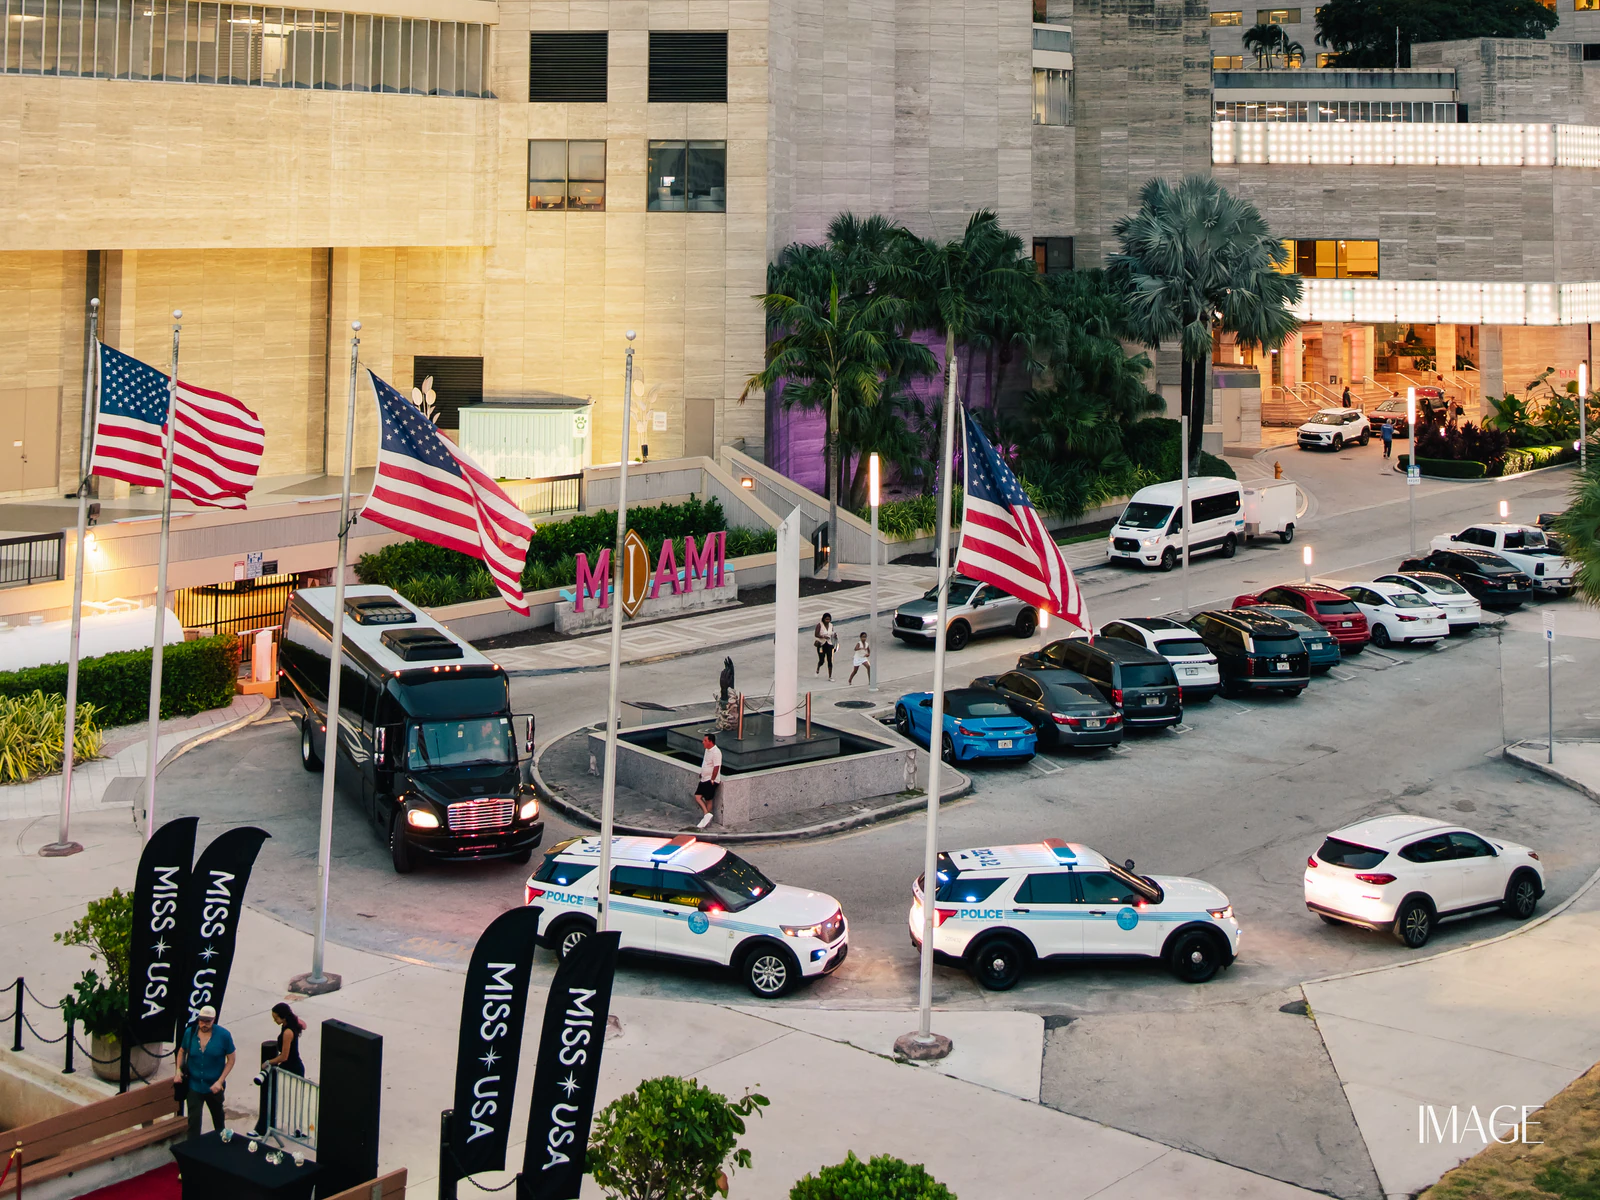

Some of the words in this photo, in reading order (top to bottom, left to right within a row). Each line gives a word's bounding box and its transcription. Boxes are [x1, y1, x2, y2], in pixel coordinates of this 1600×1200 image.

[572, 530, 727, 614] MIAMI
[150, 866, 180, 932] MISS
[200, 870, 235, 938] MISS
[546, 890, 585, 905] POLICE
[960, 908, 1004, 919] POLICE
[141, 962, 171, 1019] USA
[185, 968, 217, 1028] USA
[480, 962, 516, 1041] MISS
[559, 987, 597, 1065] MISS
[466, 1075, 500, 1143] USA
[541, 1103, 579, 1170] USA
